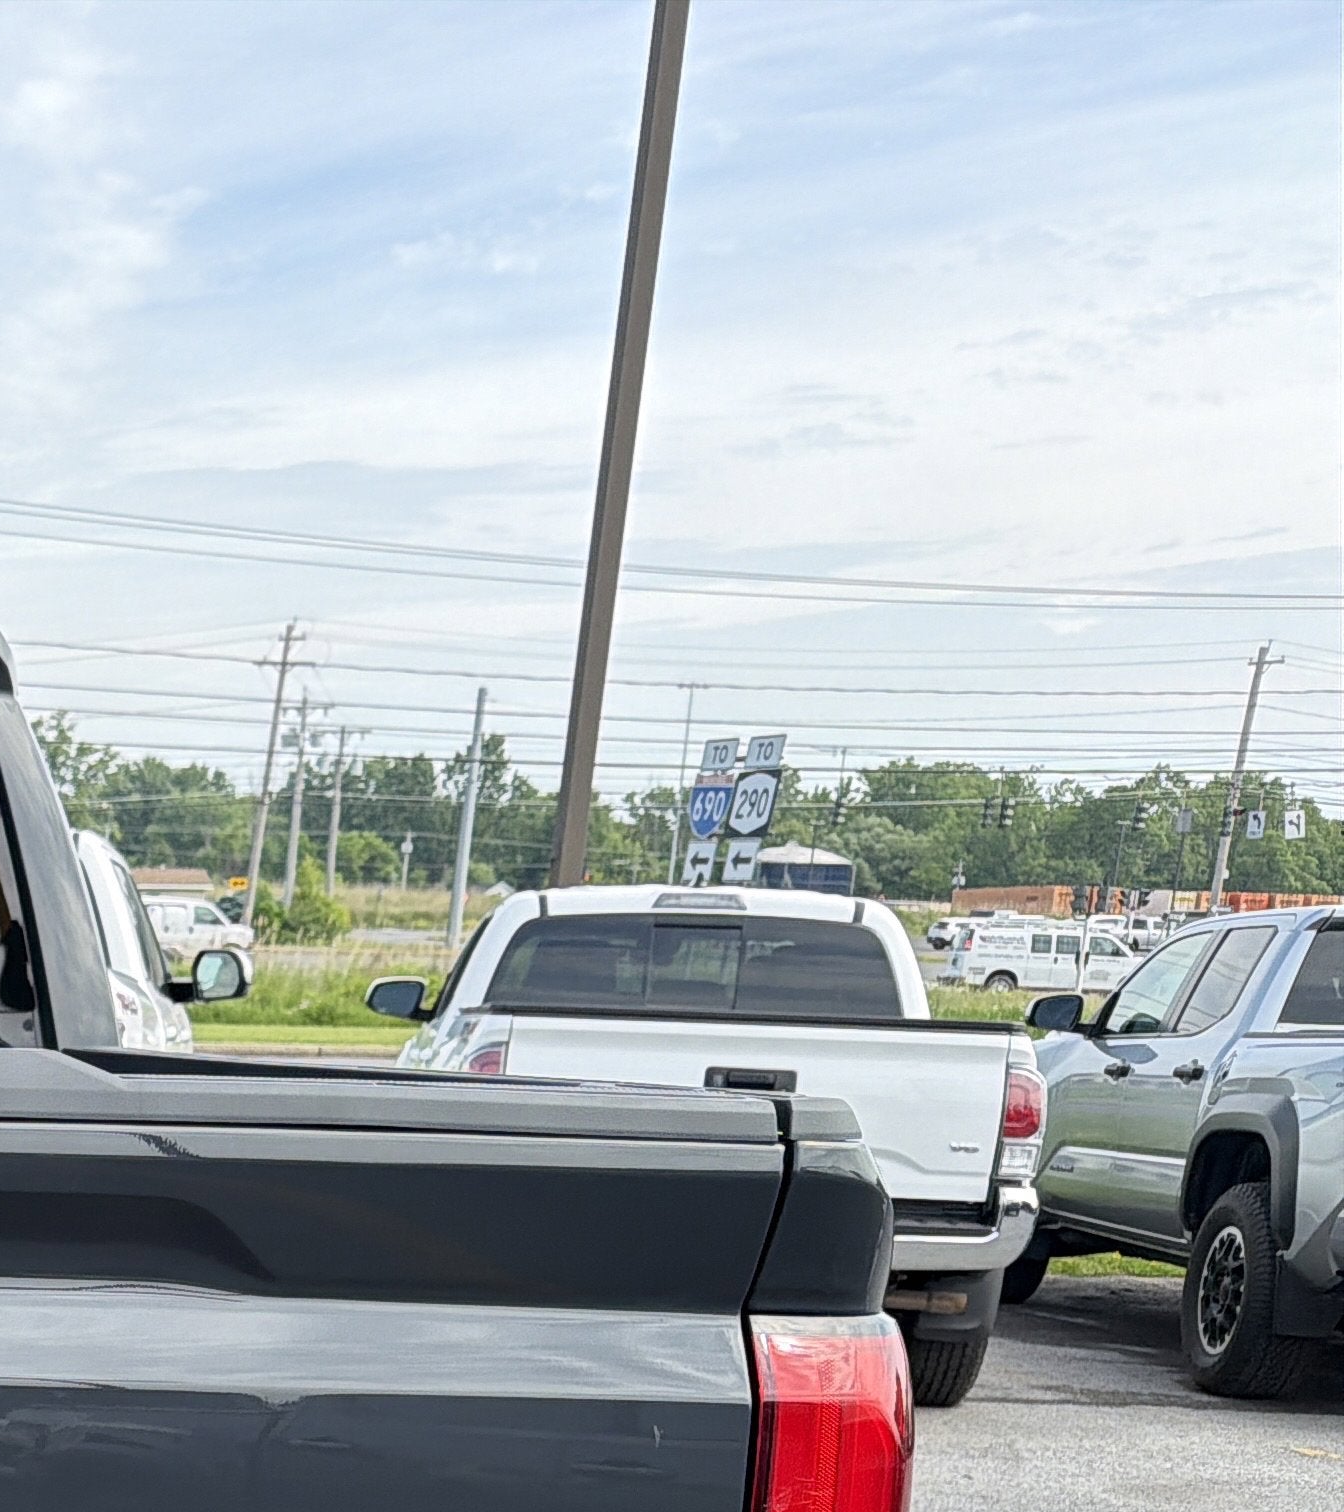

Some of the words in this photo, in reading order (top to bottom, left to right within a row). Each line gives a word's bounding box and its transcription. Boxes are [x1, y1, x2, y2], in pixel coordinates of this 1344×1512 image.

[713, 745, 729, 764] TO
[757, 741, 774, 761] TO
[692, 790, 726, 822] 690
[735, 788, 770, 819] 290
